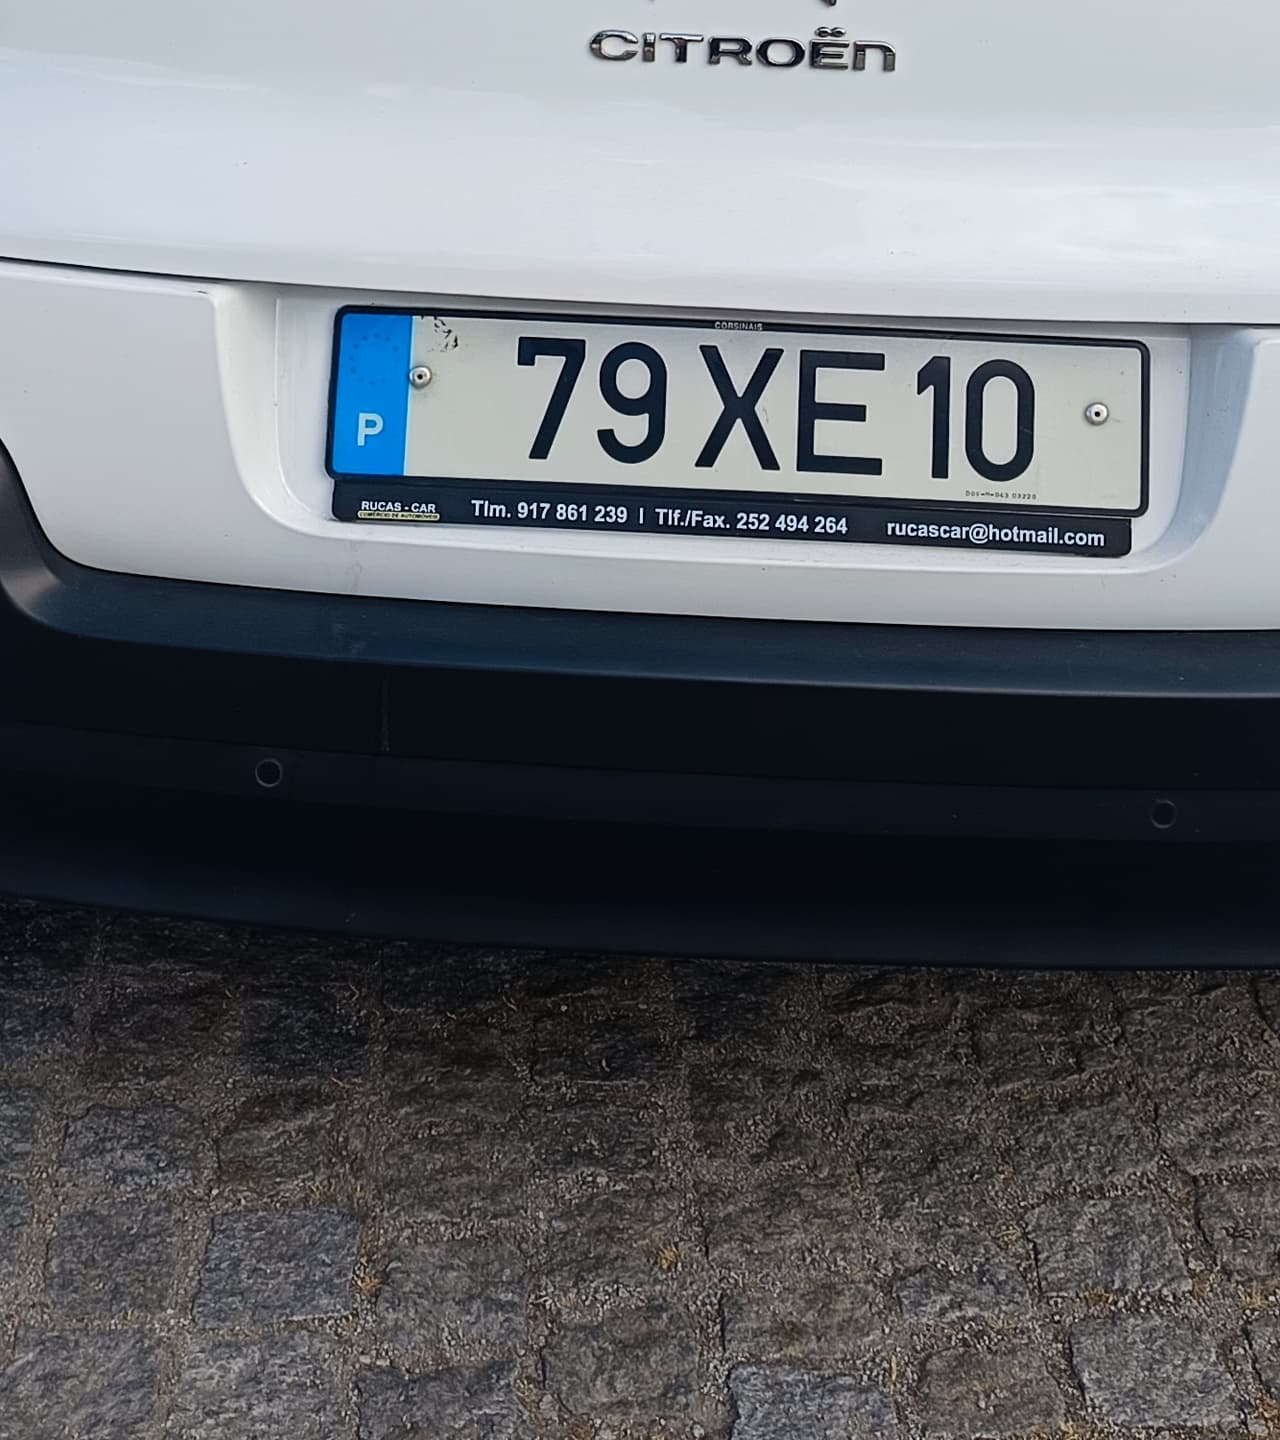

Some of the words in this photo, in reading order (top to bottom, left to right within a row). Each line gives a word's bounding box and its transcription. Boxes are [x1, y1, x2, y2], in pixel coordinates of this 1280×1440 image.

[357, 412, 384, 447] P
[517, 336, 668, 465] 79
[694, 344, 886, 476] XE
[916, 355, 1036, 482] 10
[361, 500, 402, 512] RUCAS
[411, 502, 436, 514] CAR
[471, 499, 511, 519] Tlm.
[517, 501, 551, 520] 917
[556, 503, 587, 522] 861
[594, 505, 628, 523] 239
[655, 508, 730, 530] Tlf./Fax.
[736, 512, 770, 531] 252
[775, 514, 810, 533] 494
[814, 516, 848, 535] 264
[887, 521, 1105, 547] rucascar@hotmail.com
